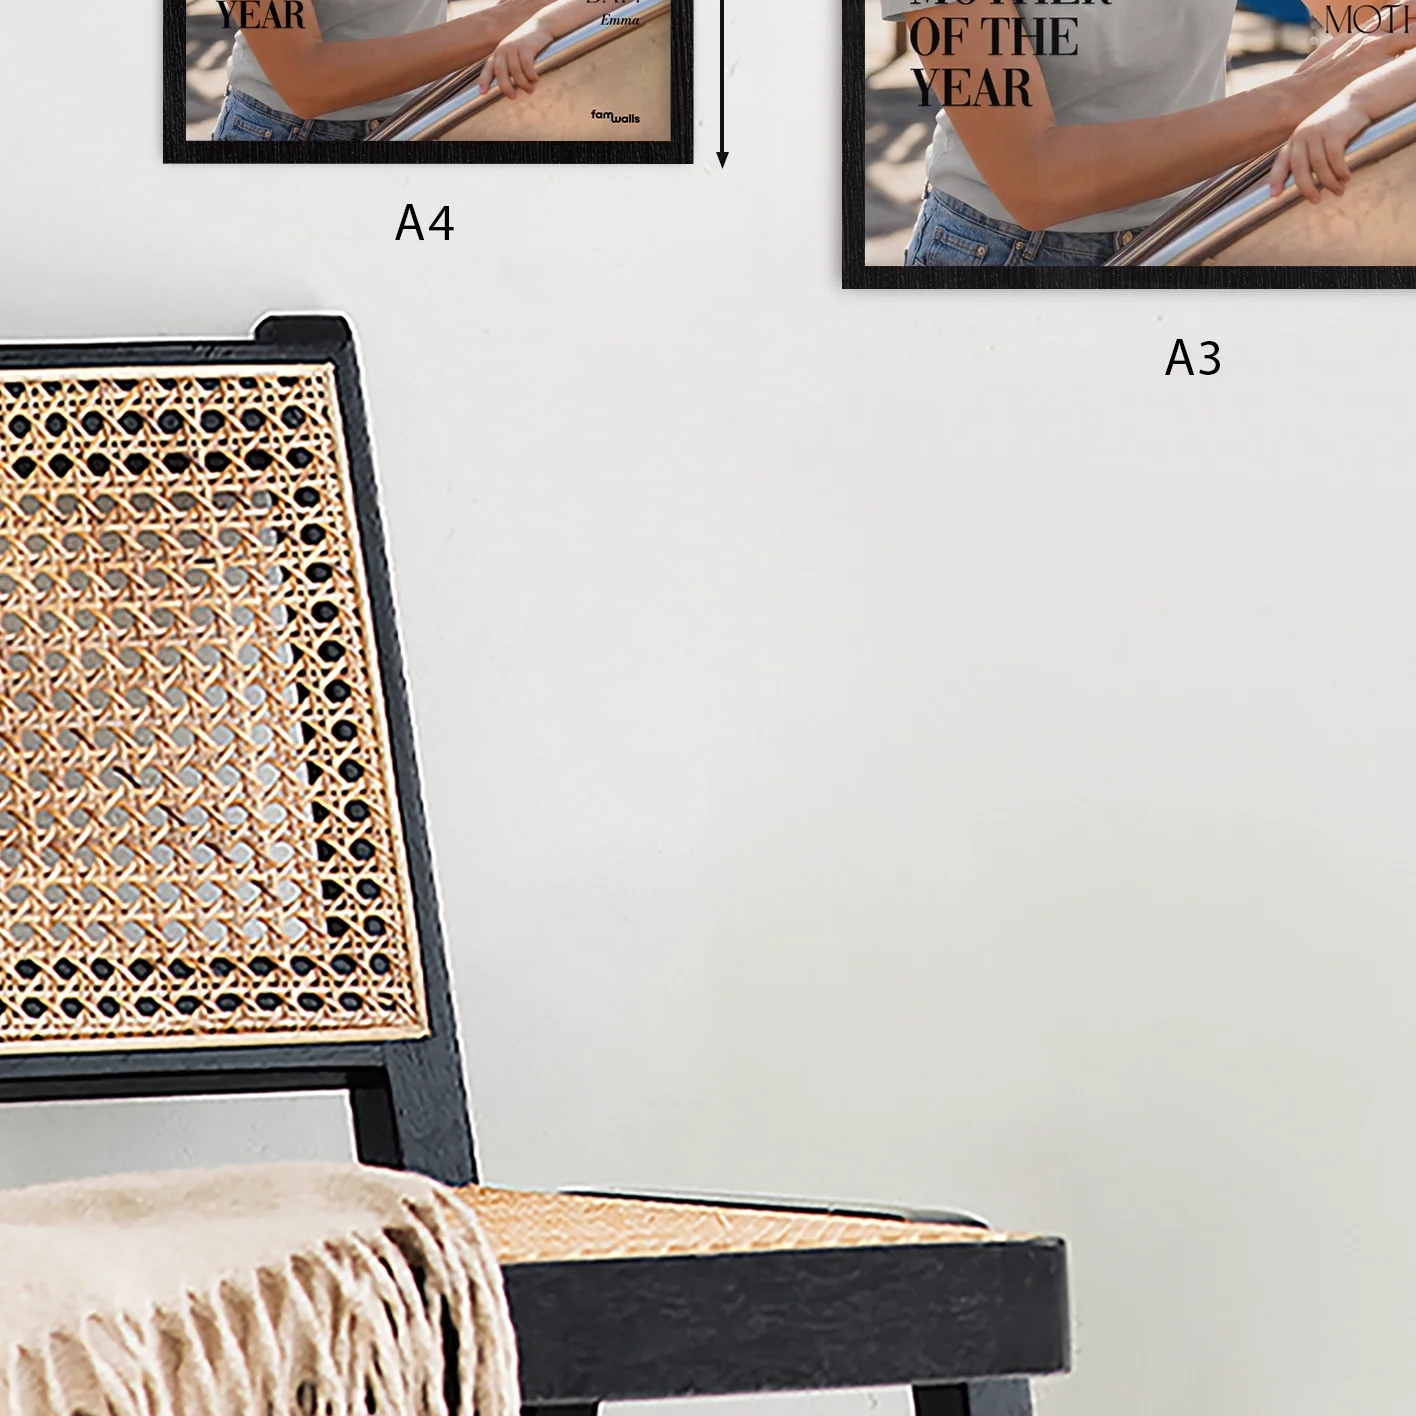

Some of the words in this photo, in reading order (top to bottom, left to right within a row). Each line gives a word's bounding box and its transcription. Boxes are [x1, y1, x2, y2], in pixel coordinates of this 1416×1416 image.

[215, 0, 306, 29] YEAR
[600, 13, 640, 26] Emma
[910, 16, 969, 56] OF
[980, 17, 1078, 56] THE
[910, 67, 1033, 107] YEAR
